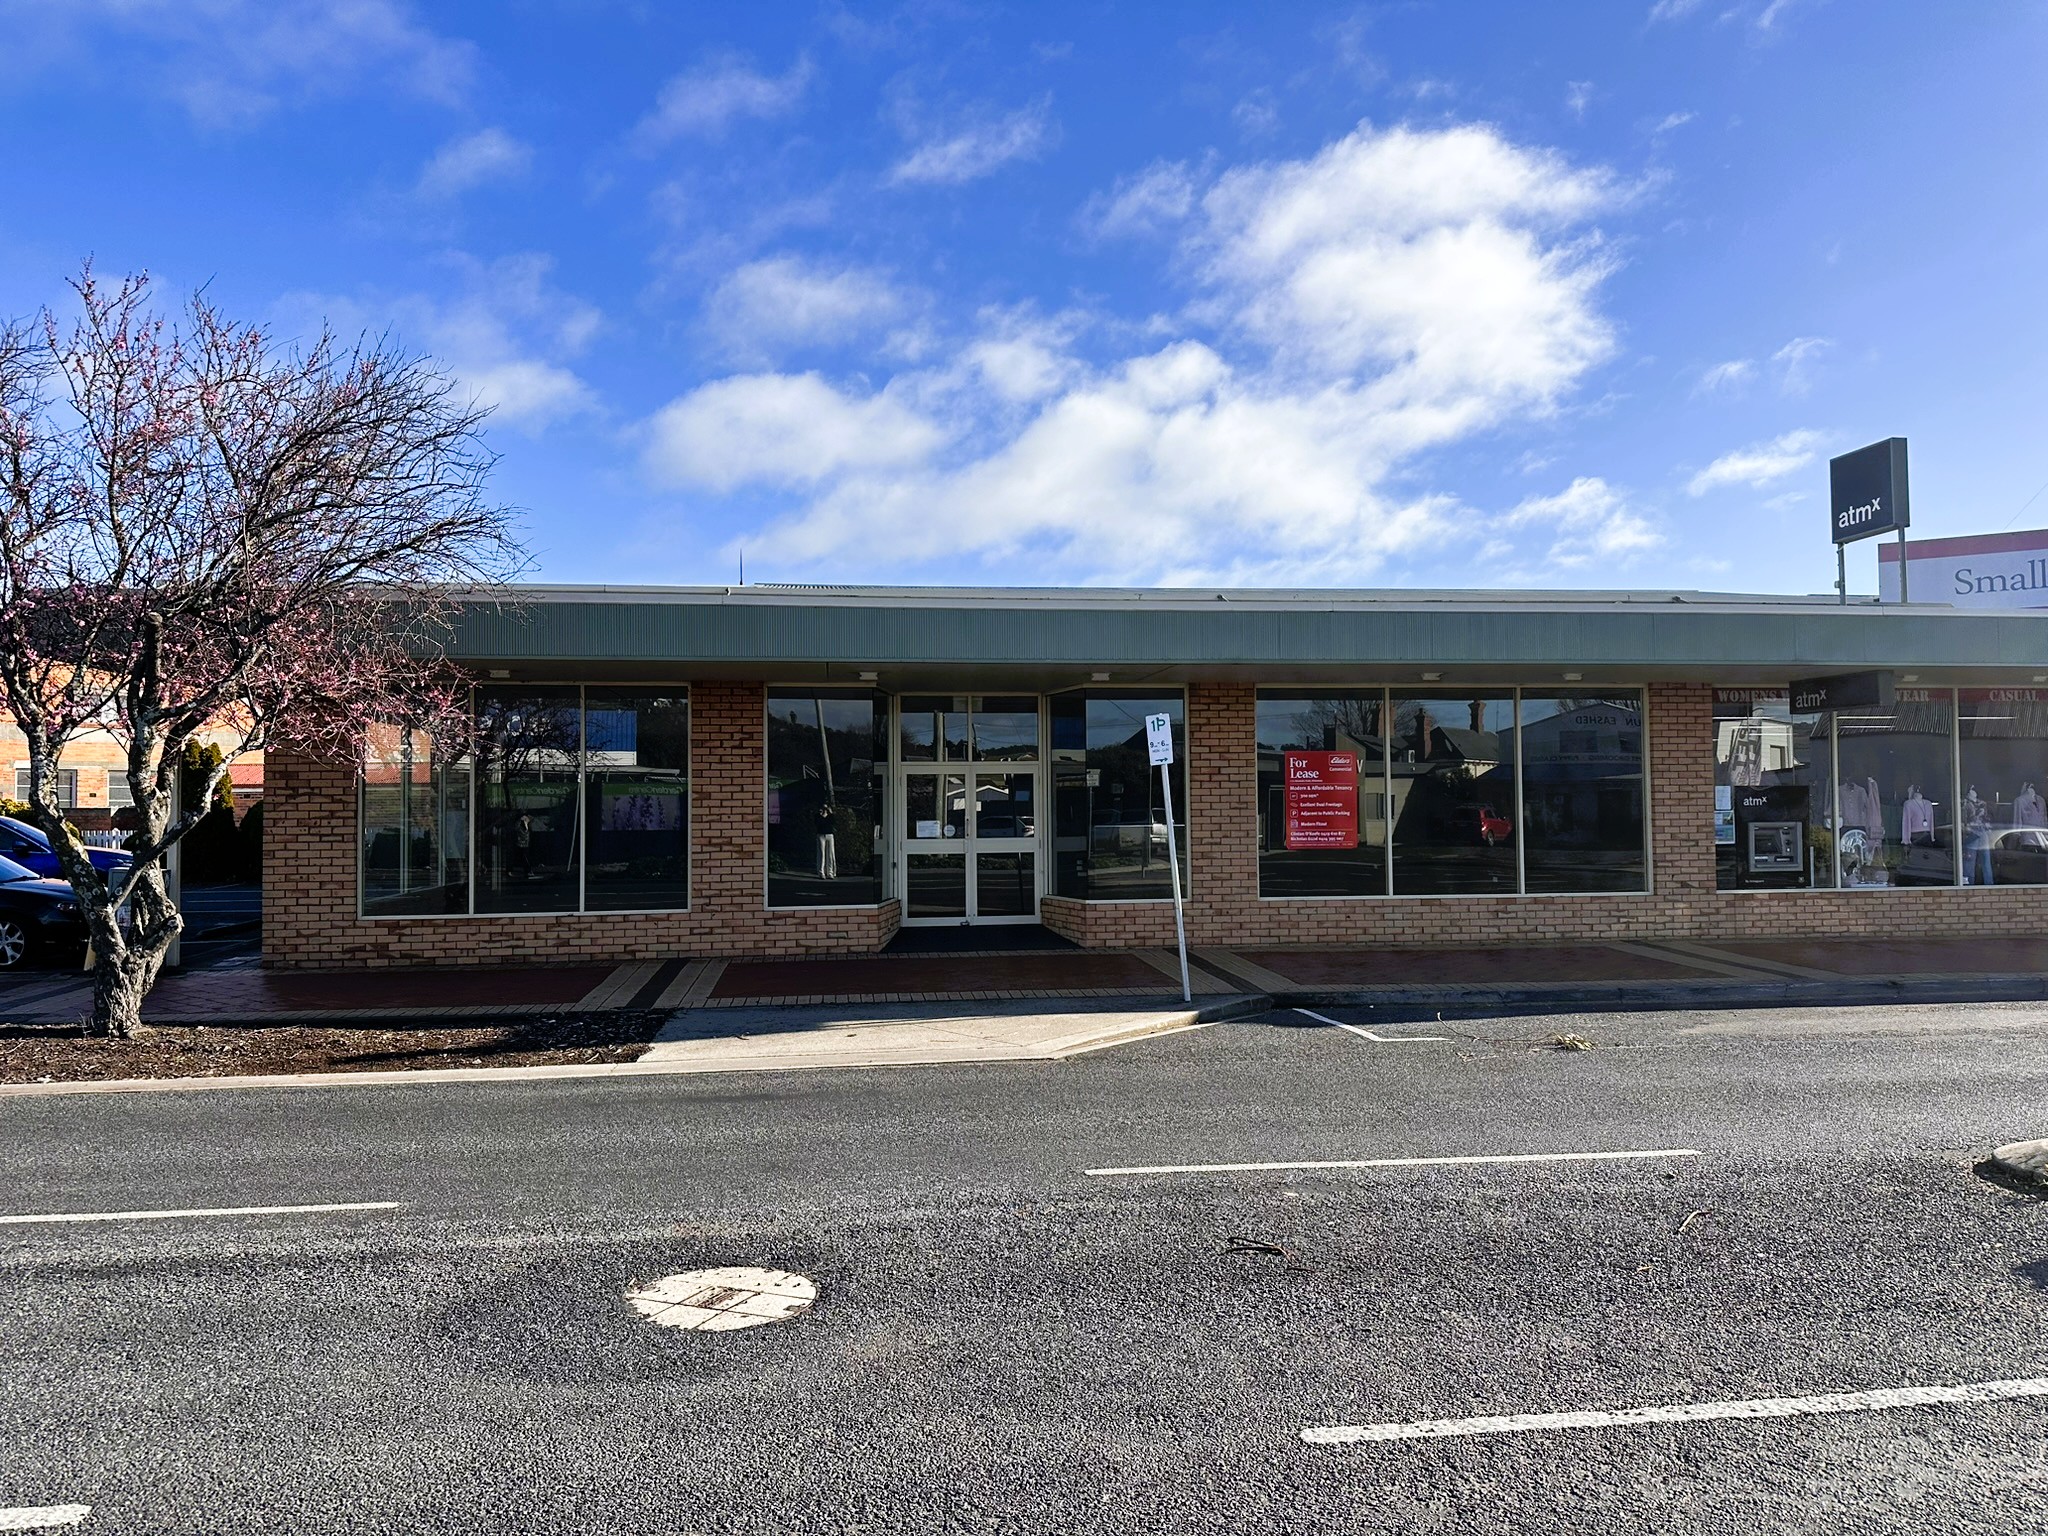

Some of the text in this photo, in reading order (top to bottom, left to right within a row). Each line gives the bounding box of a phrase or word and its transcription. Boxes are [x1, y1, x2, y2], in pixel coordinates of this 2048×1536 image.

[1954, 558, 2048, 595] Small
[1717, 690, 1778, 702] WOMENS
[1990, 689, 2039, 702] CASUAL
[1151, 717, 1165, 732] 1P
[1290, 758, 1307, 767] For
[1291, 768, 1319, 778] Lease
